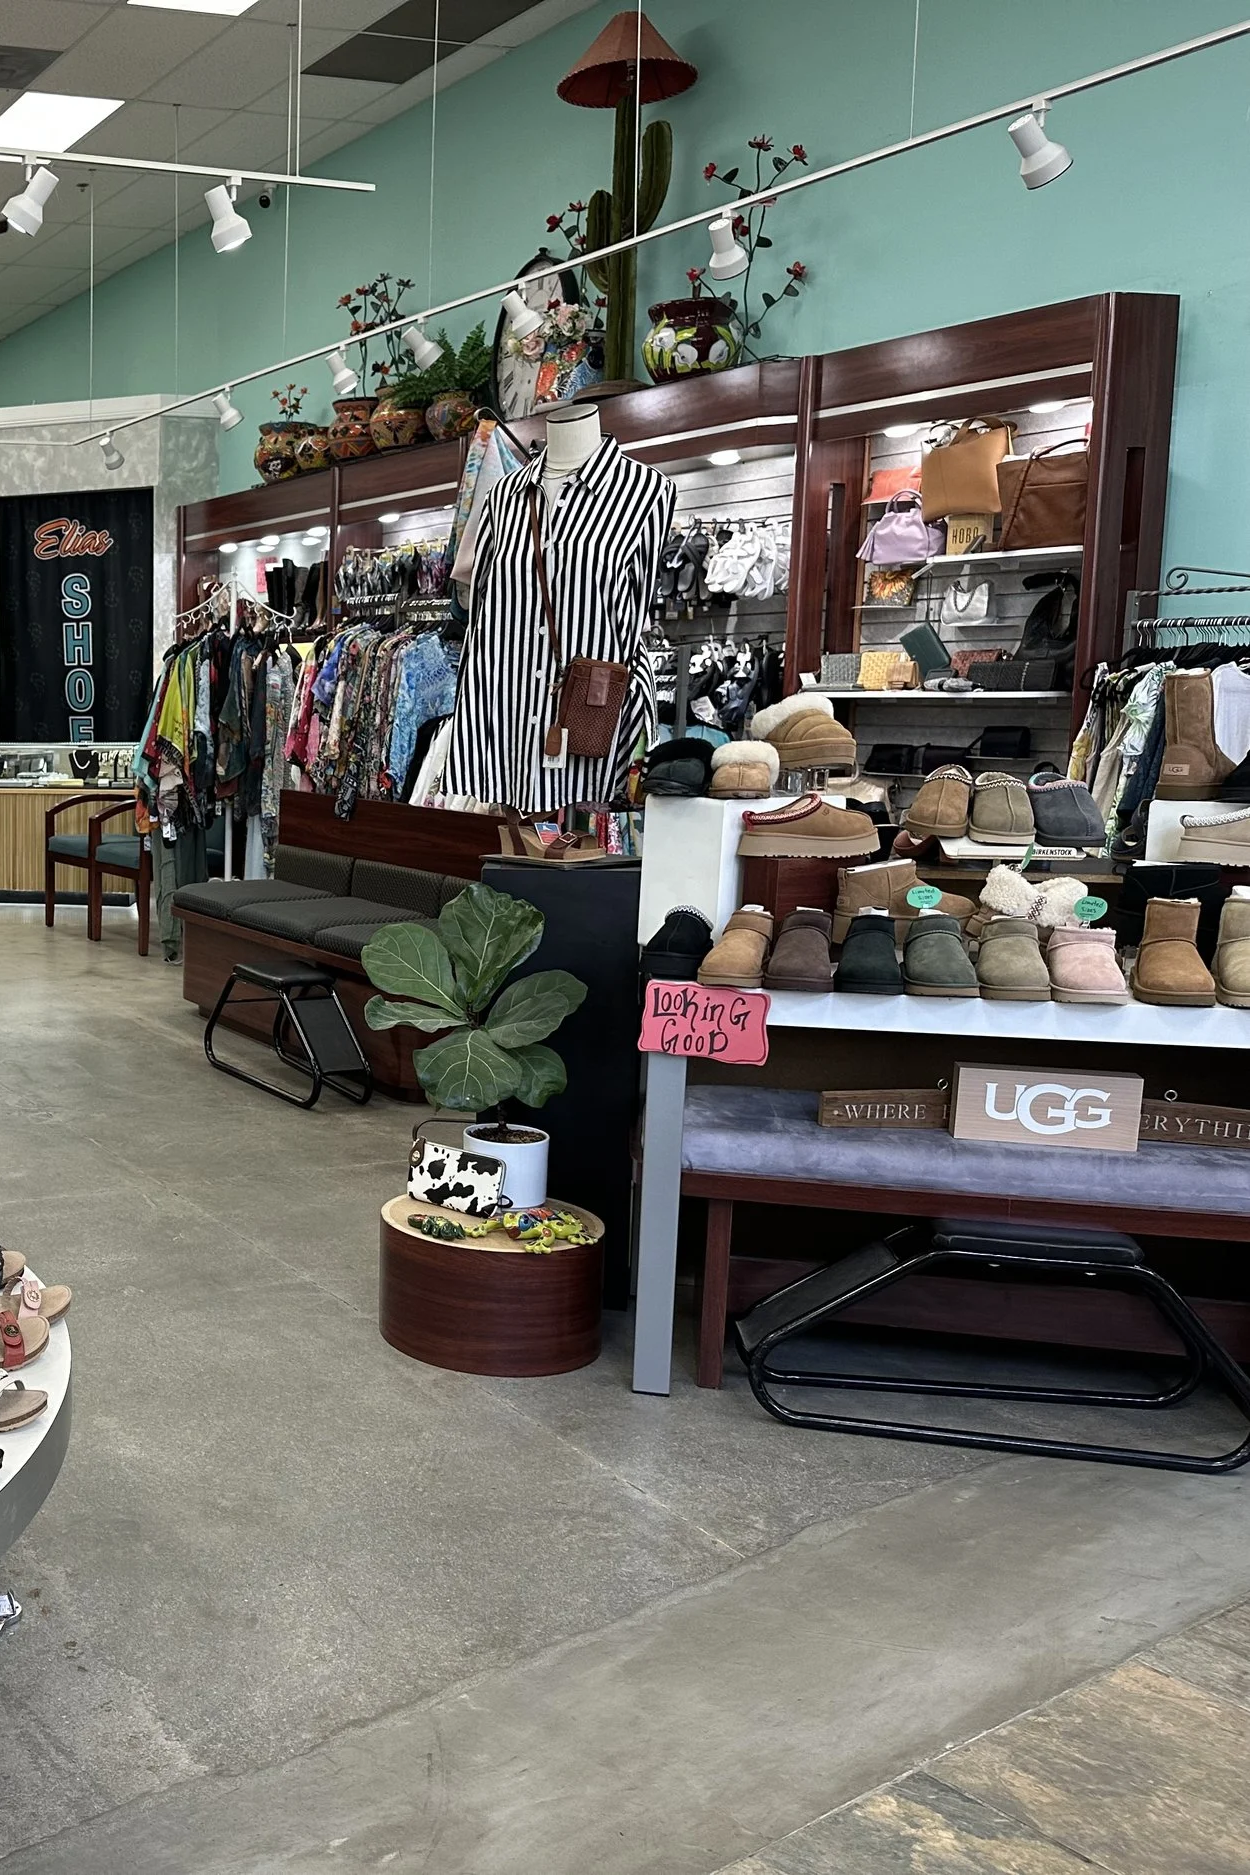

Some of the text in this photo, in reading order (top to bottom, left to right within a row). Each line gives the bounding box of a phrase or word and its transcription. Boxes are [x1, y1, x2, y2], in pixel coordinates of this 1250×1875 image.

[34, 517, 113, 560] Elias
[952, 527, 979, 544] HOBO
[1032, 847, 1073, 857] BIRKENSTOCK
[844, 1103, 927, 1120] WHERE
[985, 1082, 1112, 1135] UGG
[1141, 1113, 1250, 1140] ERYTHI
